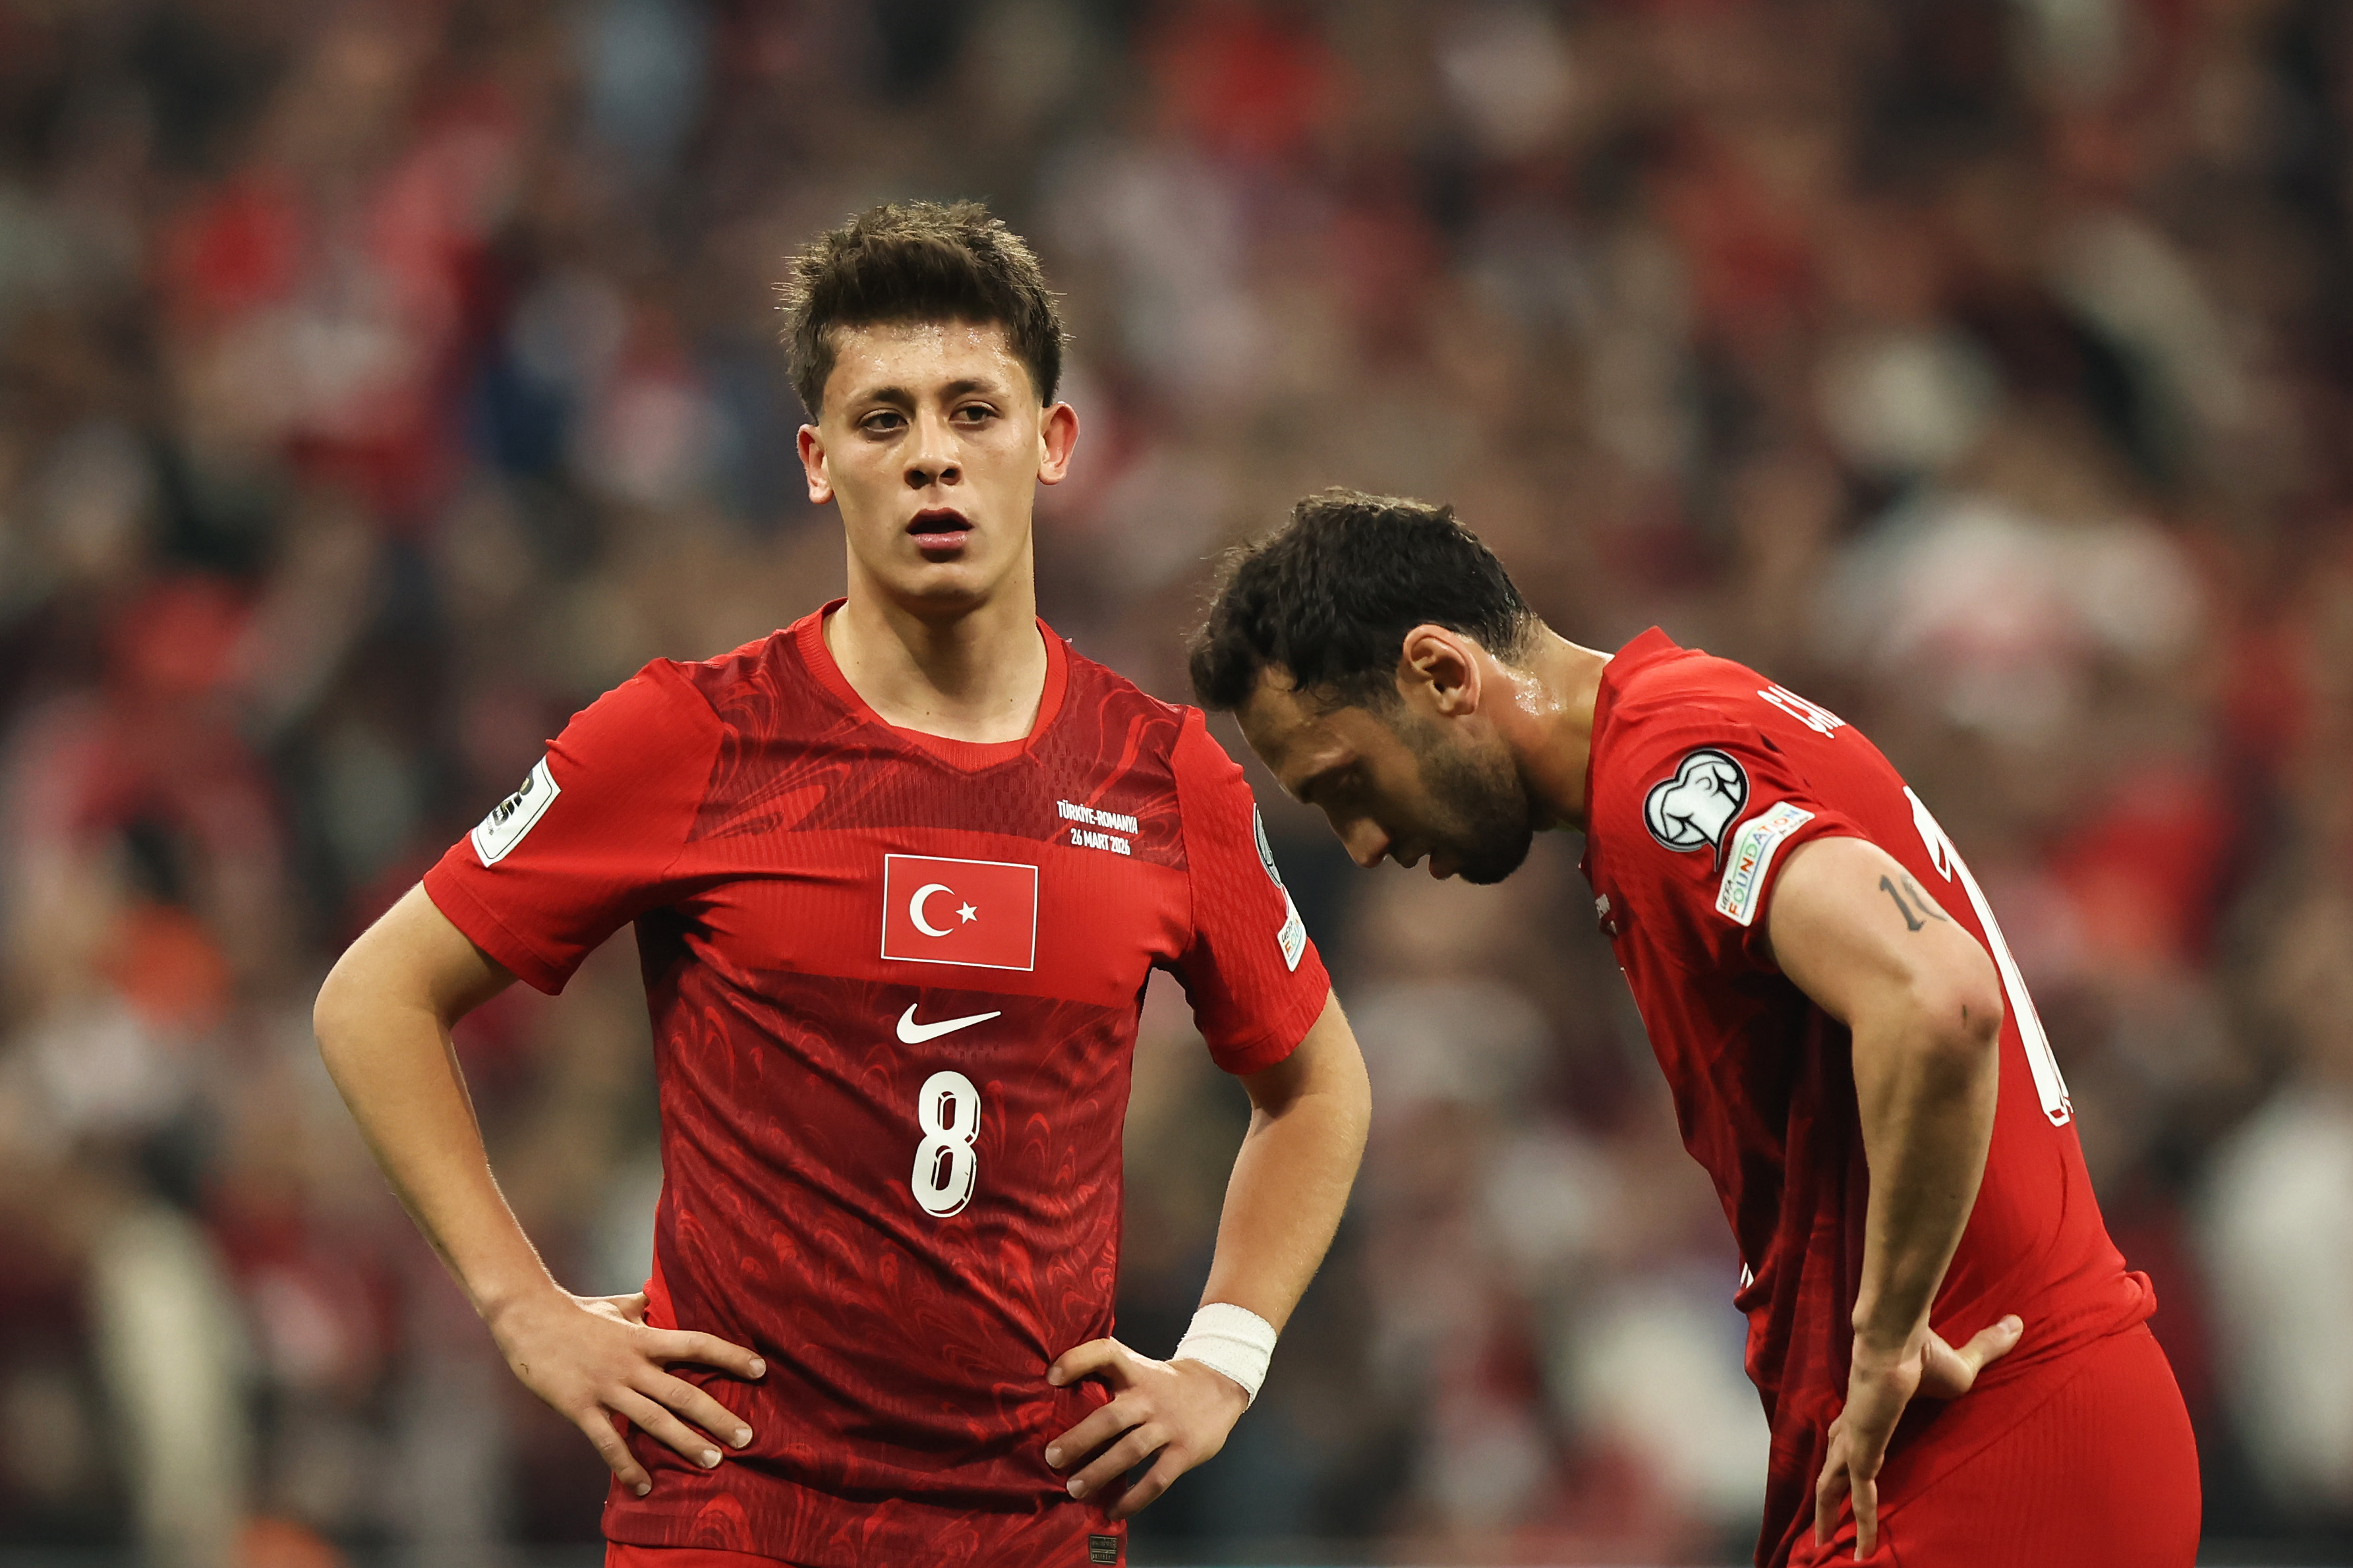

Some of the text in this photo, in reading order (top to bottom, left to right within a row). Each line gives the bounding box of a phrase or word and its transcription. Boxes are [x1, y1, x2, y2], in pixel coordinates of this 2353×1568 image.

[1057, 799, 1138, 834] TÜRKİYE-ROMANYA
[1070, 828, 1131, 856] 26 MART 2026
[1903, 785, 2074, 1128] 1
[912, 1070, 981, 1218] 8
